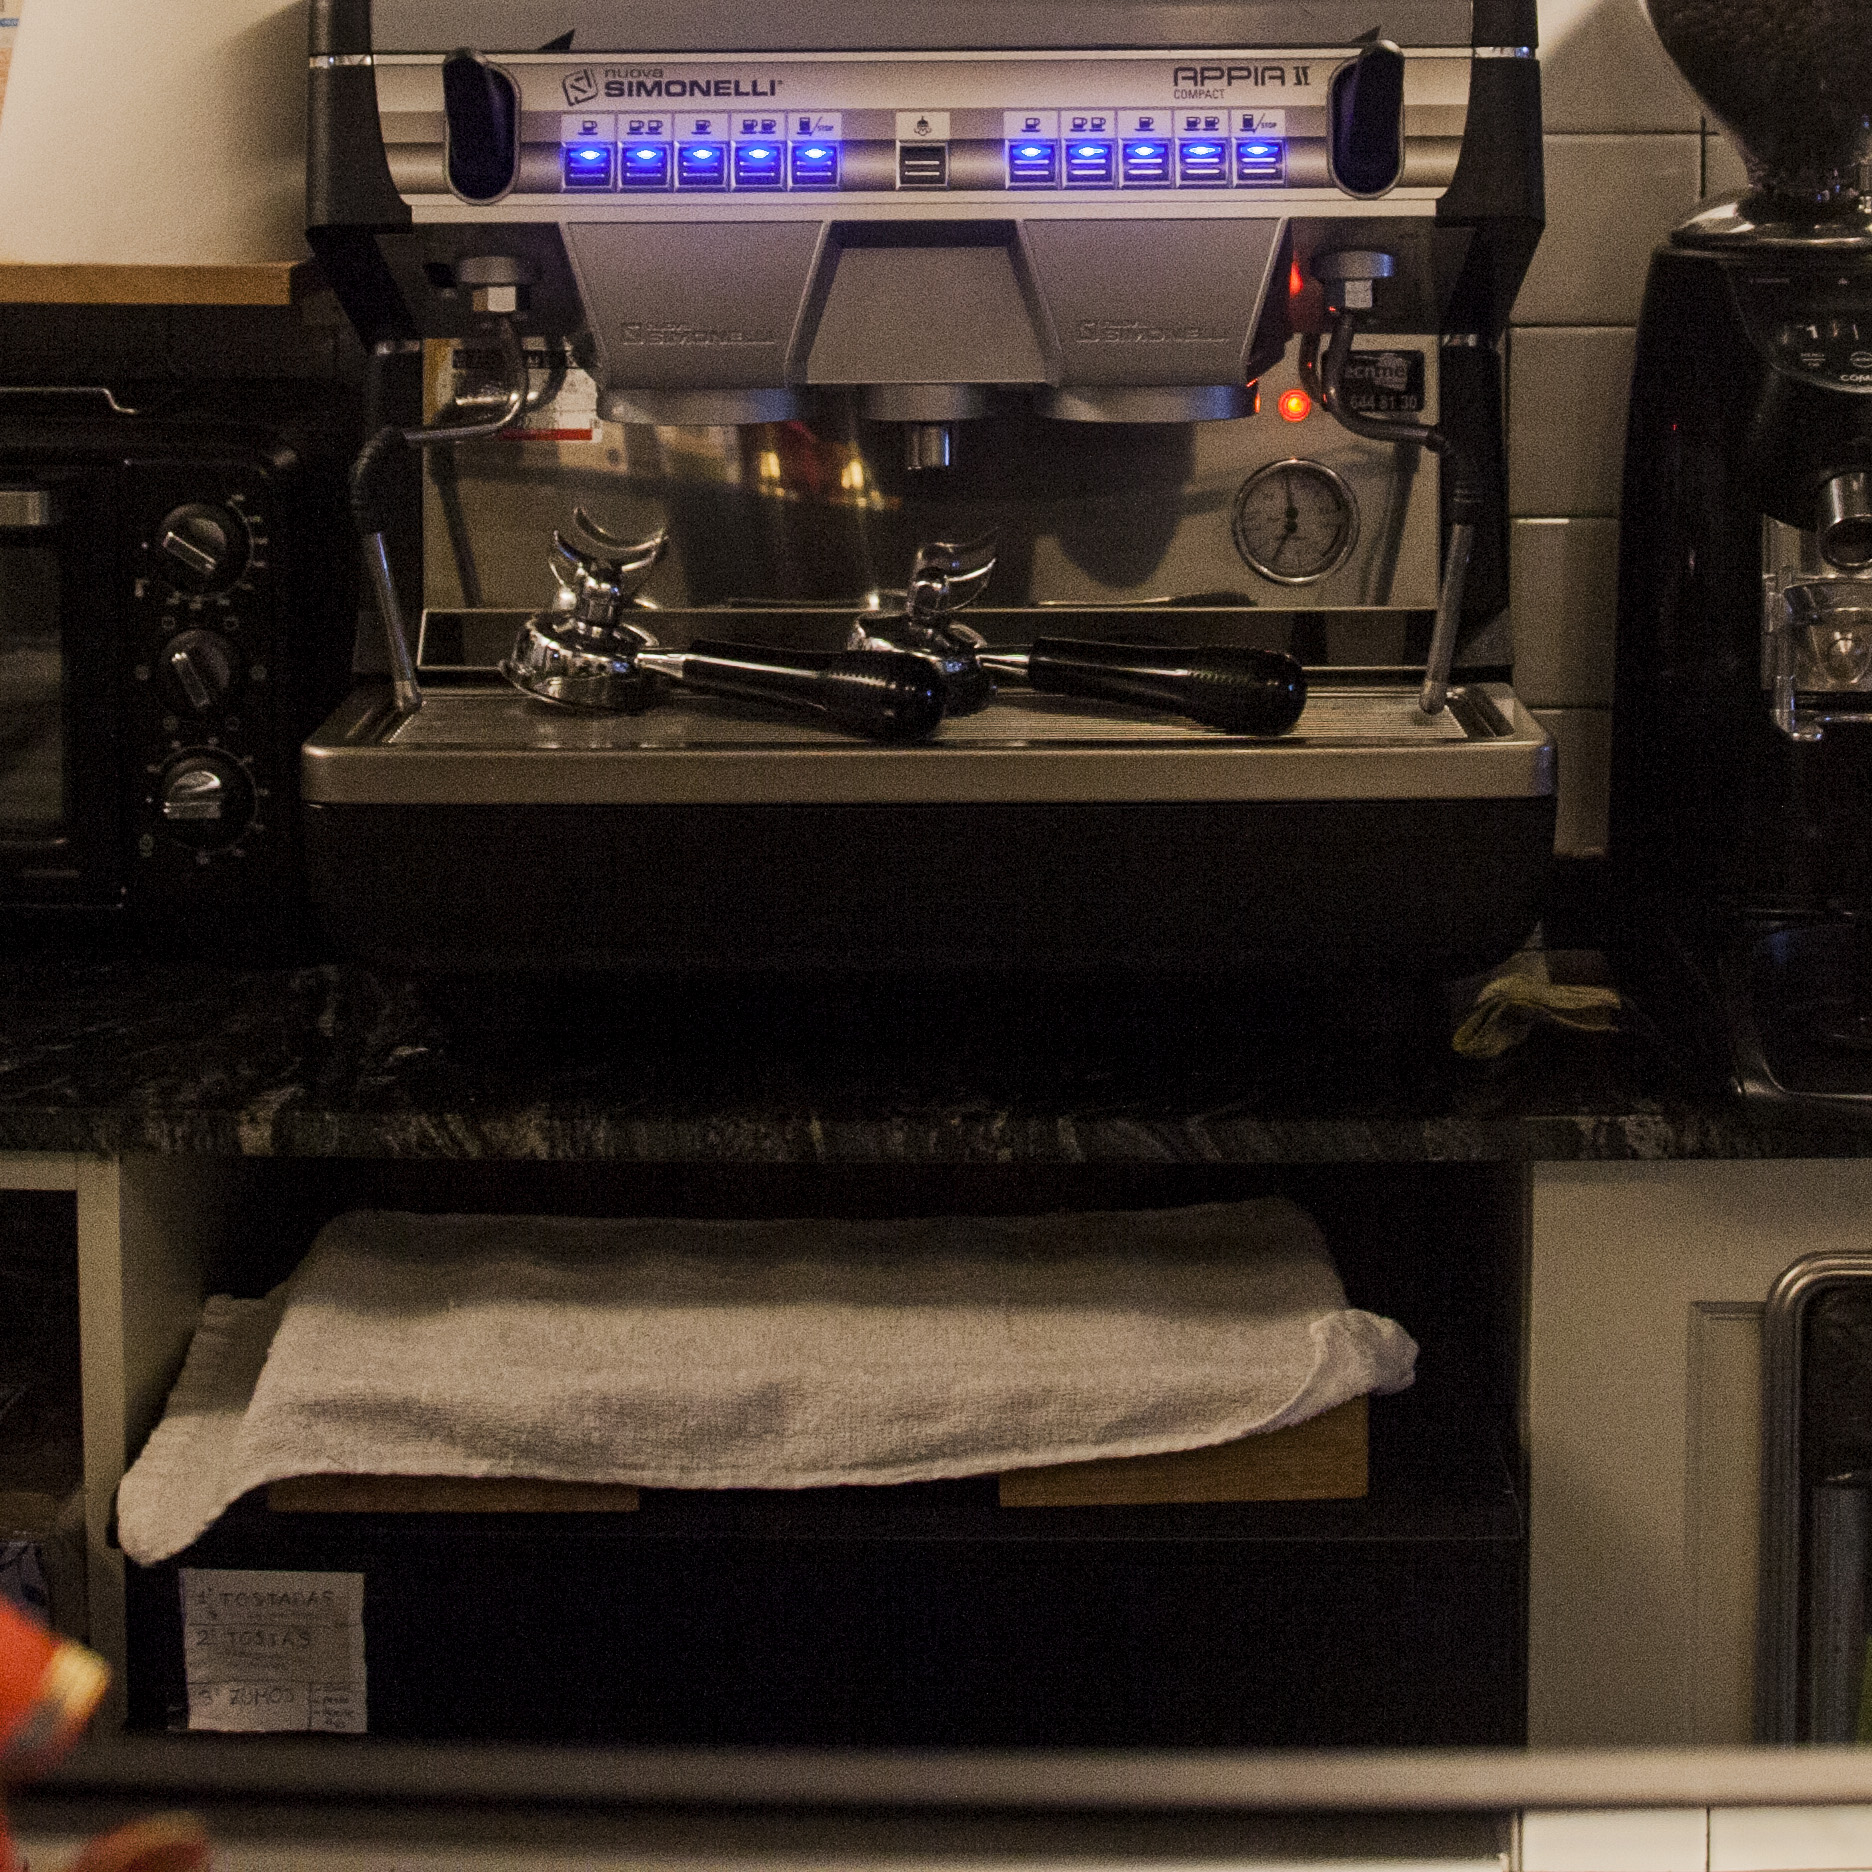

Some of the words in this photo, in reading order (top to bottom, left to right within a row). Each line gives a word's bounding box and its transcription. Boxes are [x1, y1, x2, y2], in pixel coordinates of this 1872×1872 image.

[604, 68, 664, 79] nuova
[1173, 66, 1286, 86] APPIA
[604, 79, 776, 98] SIMONELLI
[1173, 88, 1225, 99] COMPACT
